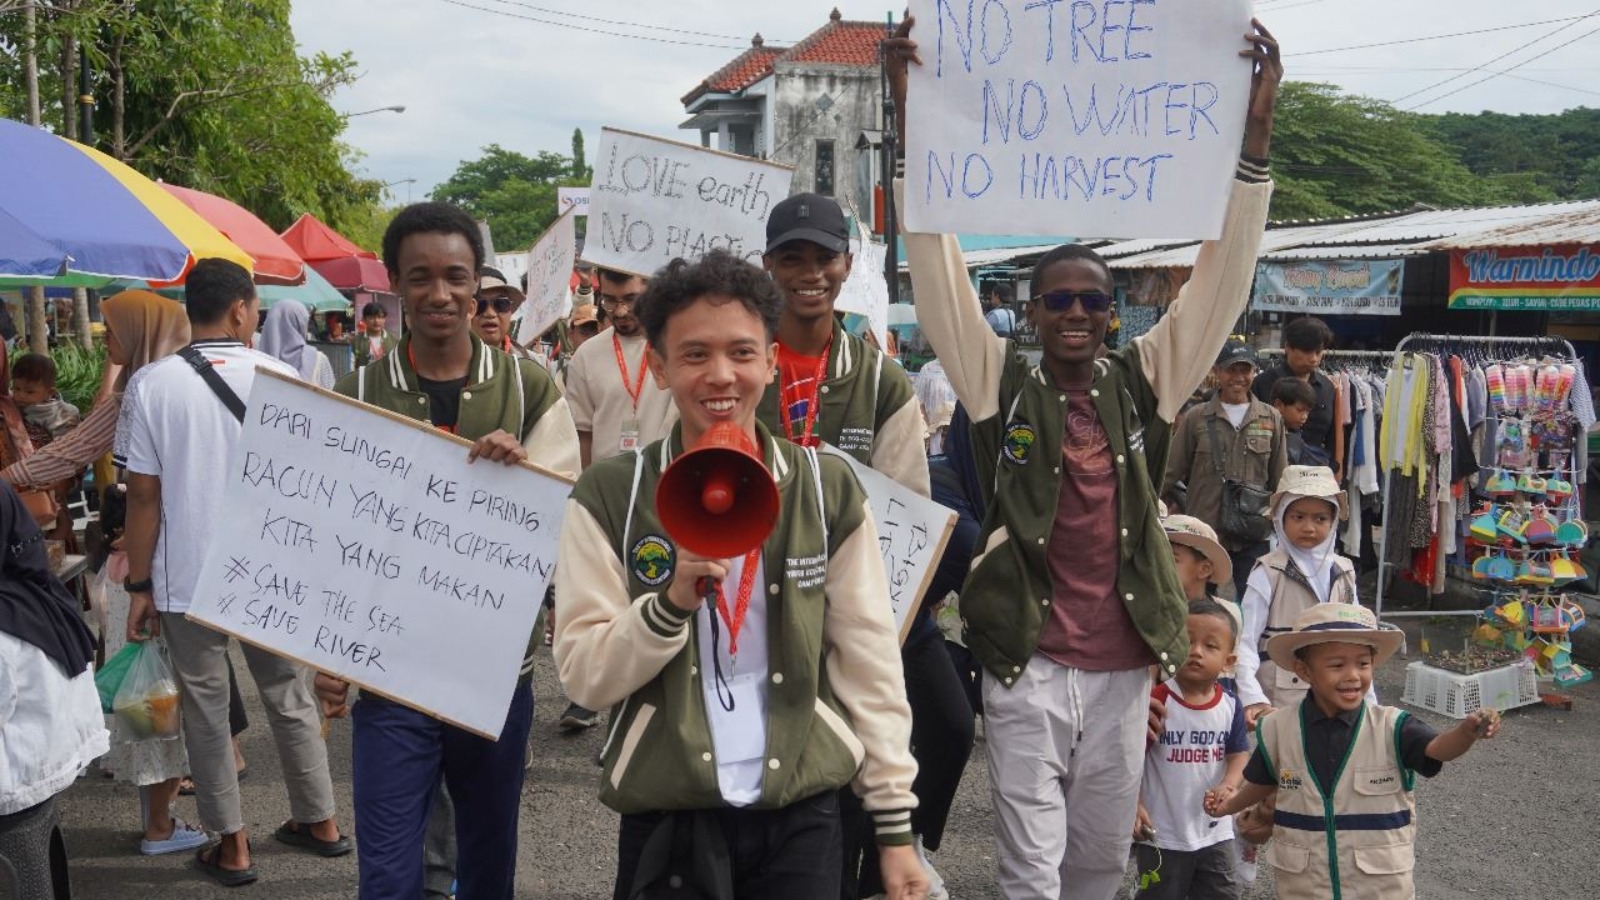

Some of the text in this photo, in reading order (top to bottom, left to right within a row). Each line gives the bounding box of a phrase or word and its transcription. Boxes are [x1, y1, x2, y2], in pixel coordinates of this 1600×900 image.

[937, 0, 1154, 78] NO TREE
[983, 79, 1219, 145] NO WATER
[599, 143, 770, 221] LOVE earth
[926, 151, 1174, 205] NO HARVEST
[601, 211, 654, 253] NO
[1463, 247, 1600, 283] Warmindo
[260, 403, 540, 532] DARI SUNGAI KE PIRING
[242, 451, 556, 583] RACUN YANG KITA CIPTAKAN
[261, 508, 505, 611] KITA YANG MAKAN
[321, 590, 355, 624] THE
[368, 605, 405, 636] SEA
[314, 625, 386, 673] RIVER
[1166, 748, 1209, 763] JUDGE
[1190, 731, 1216, 745] GOD
